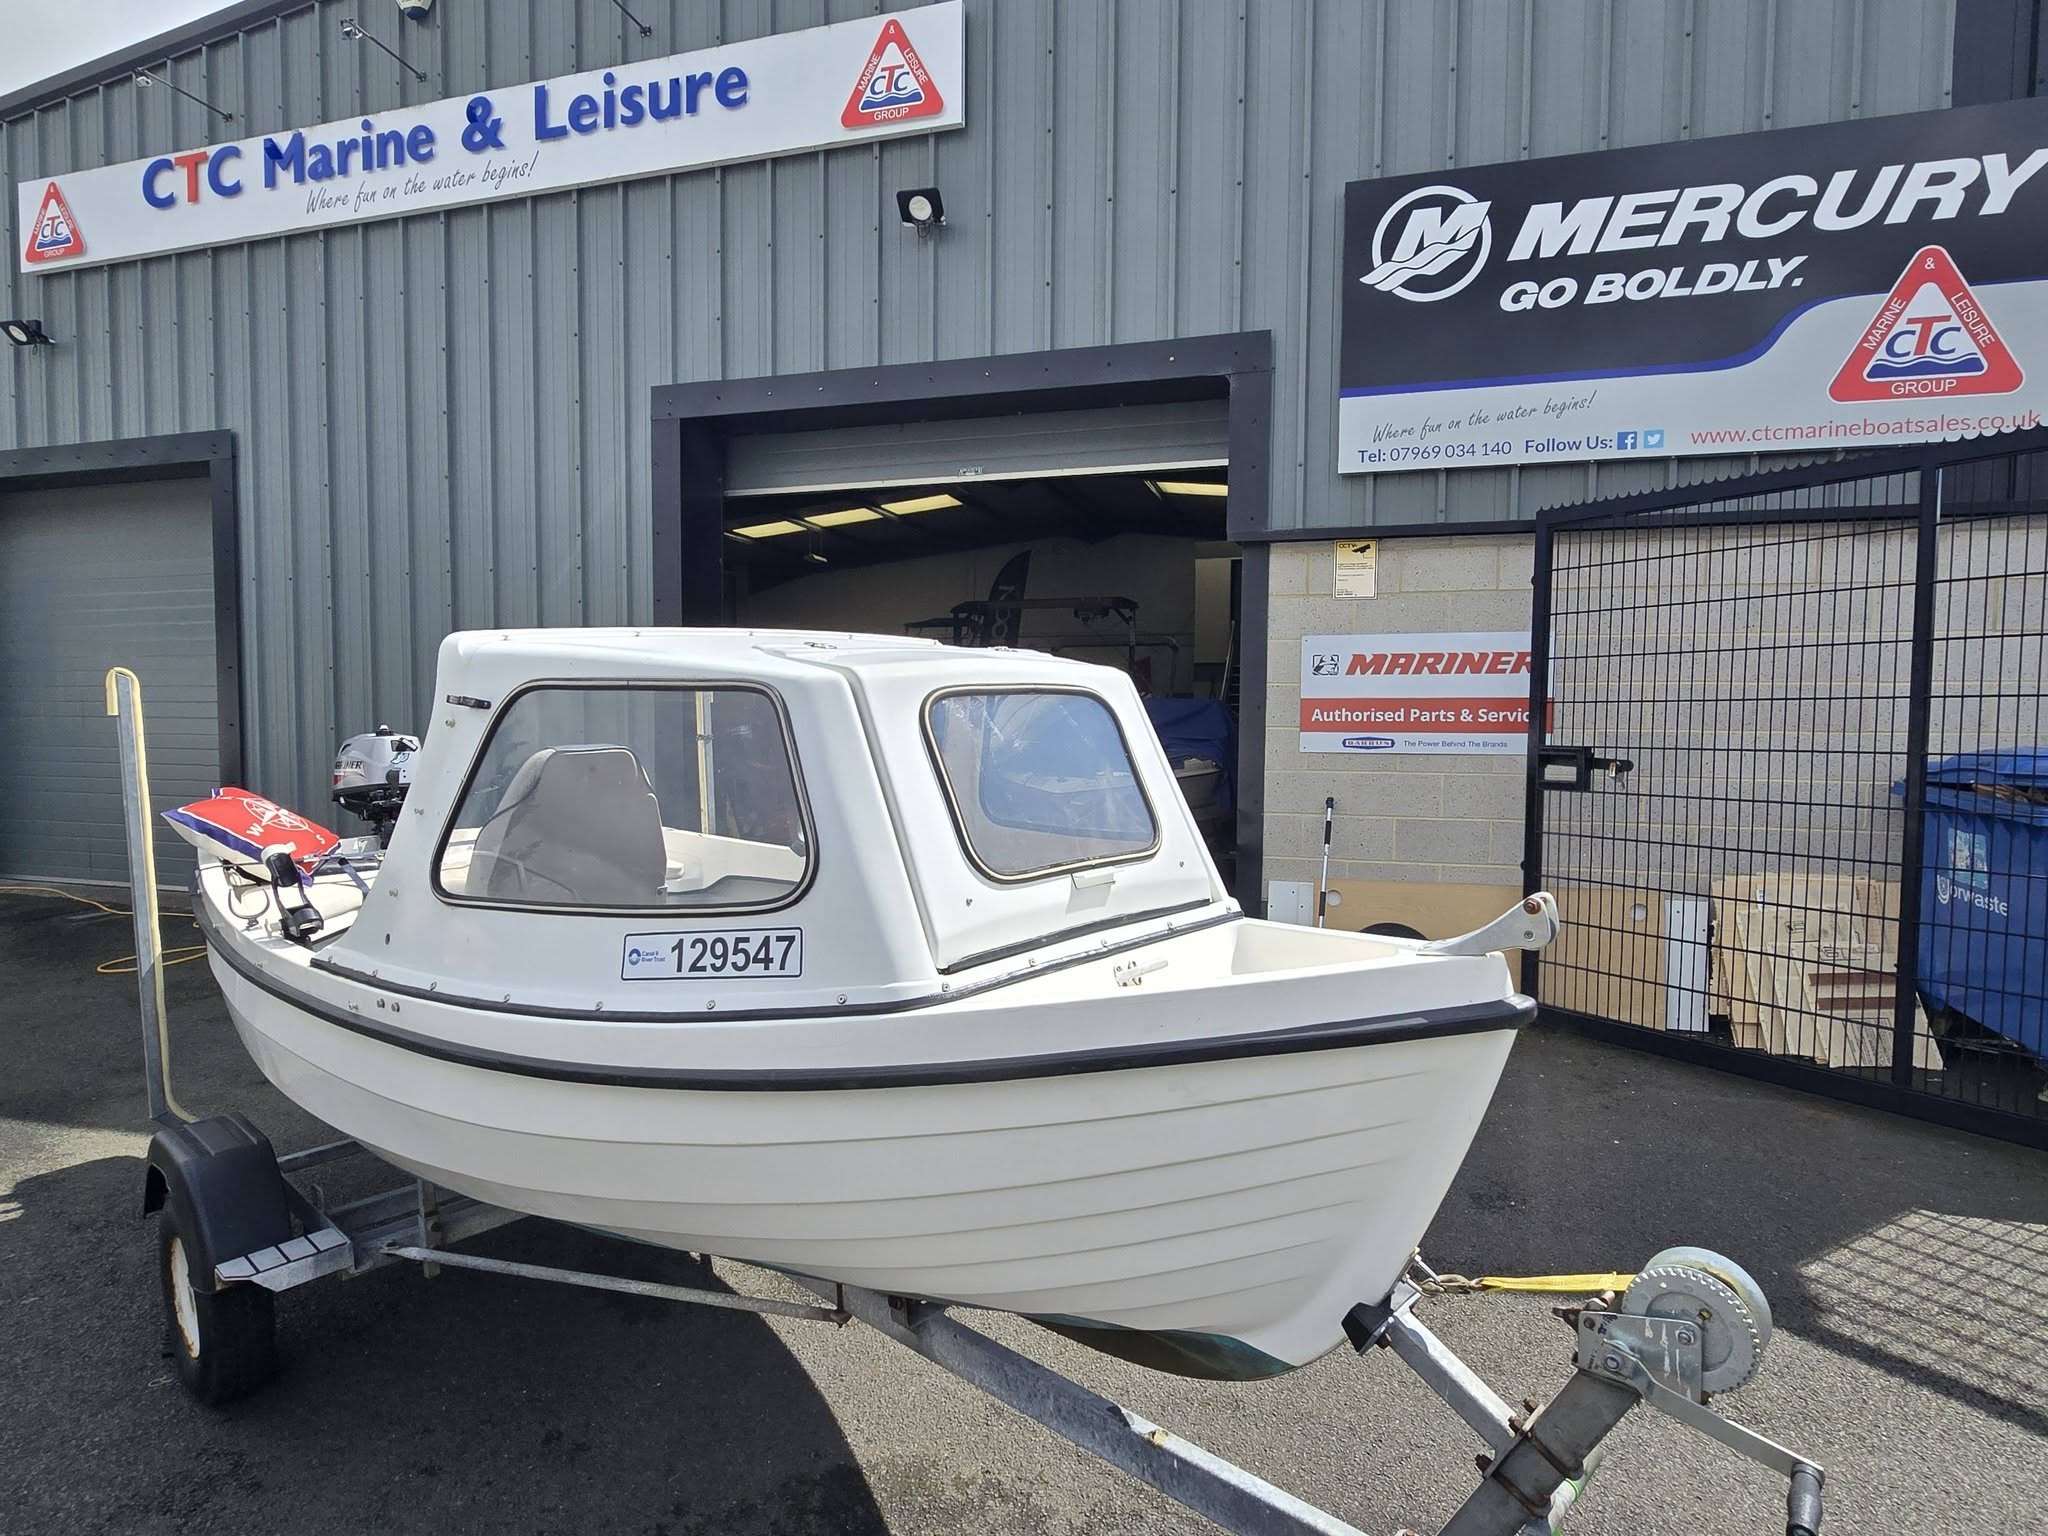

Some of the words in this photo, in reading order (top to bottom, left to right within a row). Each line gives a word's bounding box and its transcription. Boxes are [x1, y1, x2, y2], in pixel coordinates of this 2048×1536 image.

[858, 53, 881, 91] MARINE
[870, 64, 910, 95] CTC
[903, 47, 929, 85] LEISURE
[874, 107, 909, 120] GROUP
[142, 146, 241, 209] CTC
[264, 119, 435, 189] Marine
[461, 95, 505, 153] &
[534, 66, 749, 141] Leisure
[306, 186, 349, 215] Where
[354, 181, 376, 213] fun
[383, 185, 397, 200] on
[404, 172, 426, 196] the
[433, 170, 477, 190] water
[481, 150, 540, 189] begins!
[1506, 148, 2048, 262] MERCURY
[41, 215, 64, 238] CTC
[44, 248, 65, 258] GROUP
[1924, 257, 1936, 270] &
[1499, 279, 1579, 312] GO
[1583, 255, 1808, 306] BOLDLY.
[1862, 297, 1907, 350] MARINE
[1885, 314, 1962, 358] CTC
[1950, 291, 1996, 348] LEISURE
[1891, 379, 1957, 395] GROUP
[1372, 425, 1415, 443] Where
[1419, 417, 1442, 440] fun
[1447, 419, 1461, 430] on
[1469, 408, 1490, 426] the
[1496, 407, 1538, 423] water
[1544, 389, 1597, 420] begins!
[1691, 409, 2041, 445] www.ctcmarineboatsales.co.uk
[1357, 449, 1387, 463] Tel:
[1390, 445, 1441, 462] 07969
[1444, 444, 1477, 458] 034
[1481, 441, 1512, 456] 140
[1524, 437, 1582, 453] Follow
[1586, 434, 1613, 450] Us:
[1345, 652, 1531, 675] MARINER
[1311, 708, 1405, 722] Authorised
[1410, 708, 1455, 722] Parts
[1461, 708, 1473, 722] &
[1478, 708, 1529, 722] Servic
[1418, 740, 1440, 748] Power
[1441, 740, 1466, 748] Behind
[671, 935, 796, 973] 129547
